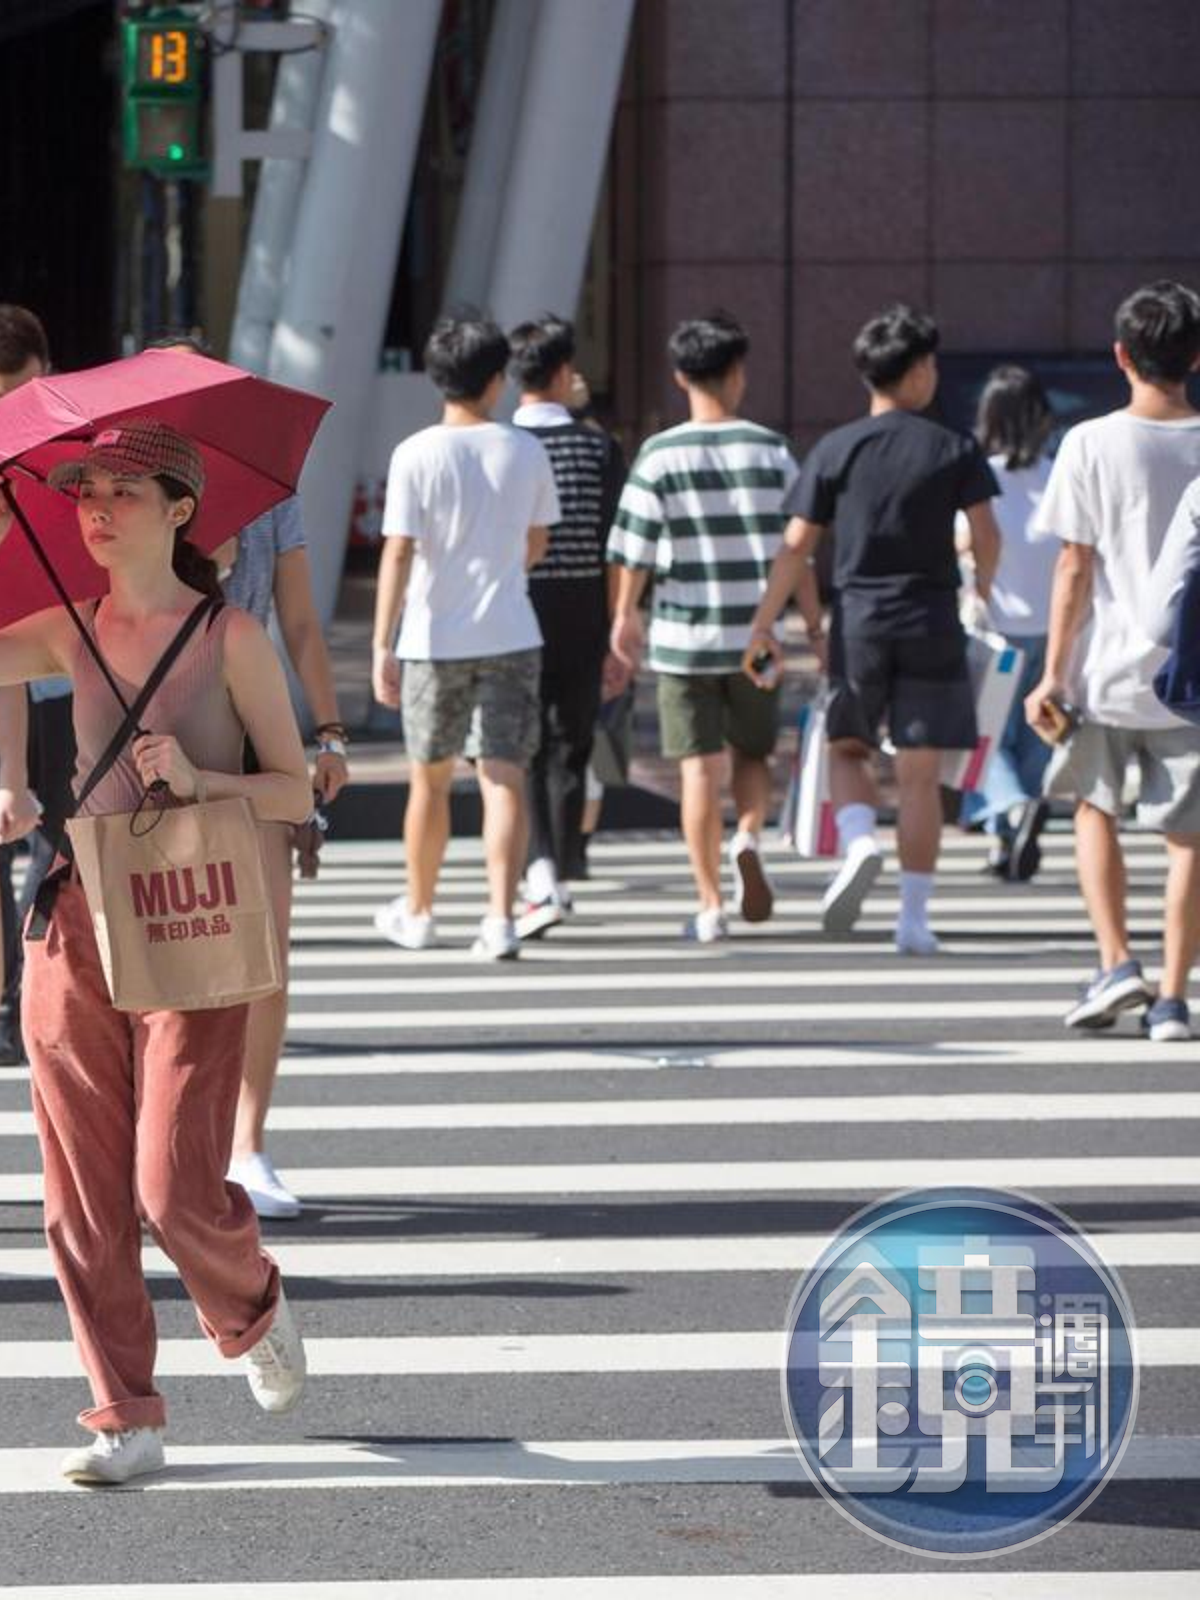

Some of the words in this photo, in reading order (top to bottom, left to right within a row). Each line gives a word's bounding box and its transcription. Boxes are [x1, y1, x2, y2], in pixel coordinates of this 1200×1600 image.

[152, 32, 188, 84] 13
[130, 861, 237, 917] MUJI
[146, 914, 232, 943] 無印良品
